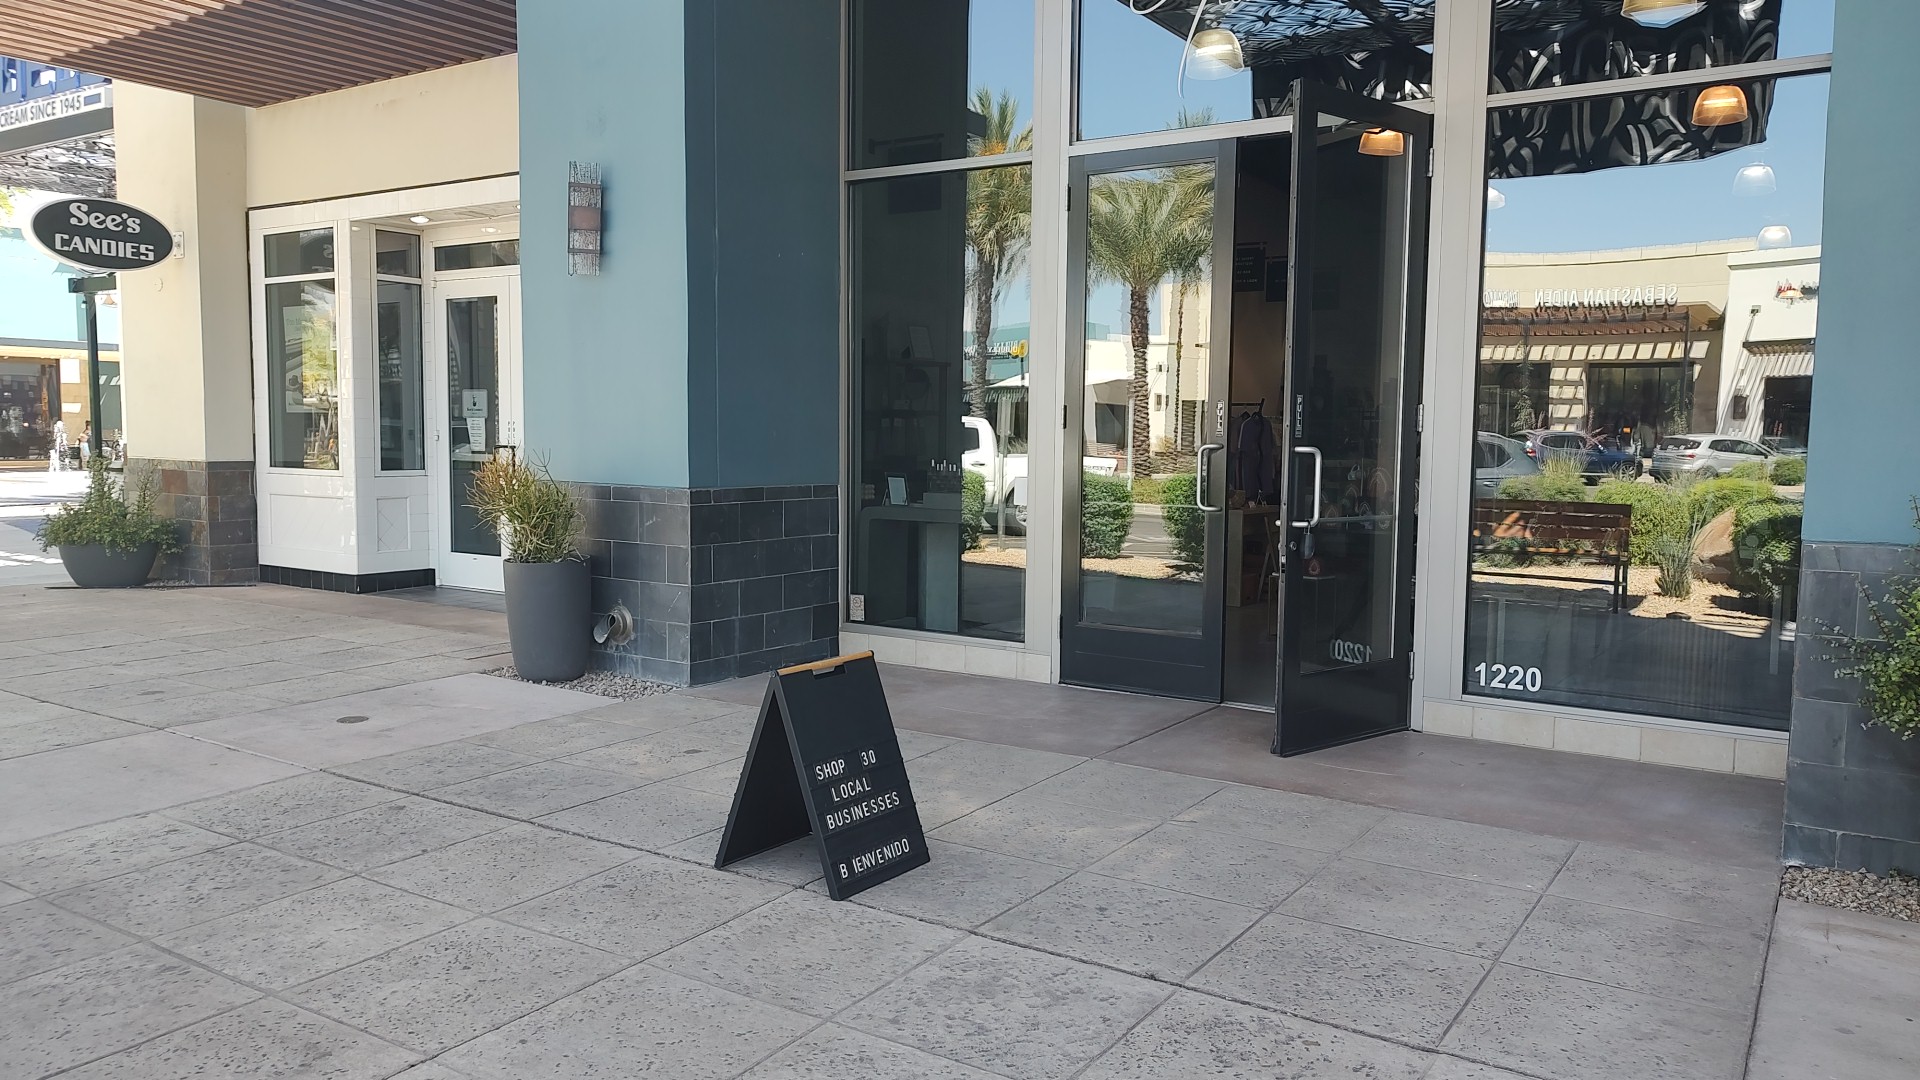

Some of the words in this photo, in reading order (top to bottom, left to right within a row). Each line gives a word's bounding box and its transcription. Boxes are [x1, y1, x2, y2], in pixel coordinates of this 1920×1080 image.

[0, 106, 29, 127] CREAM
[30, 100, 57, 121] SINCE
[60, 94, 82, 114] 1945
[69, 202, 141, 234] See's
[54, 233, 155, 261] CANDIES
[1474, 662, 1542, 692] 1220
[815, 759, 845, 780] SHOP
[861, 750, 876, 766] 30
[831, 777, 871, 802] LOCAL
[826, 791, 900, 830] BUSINESSES
